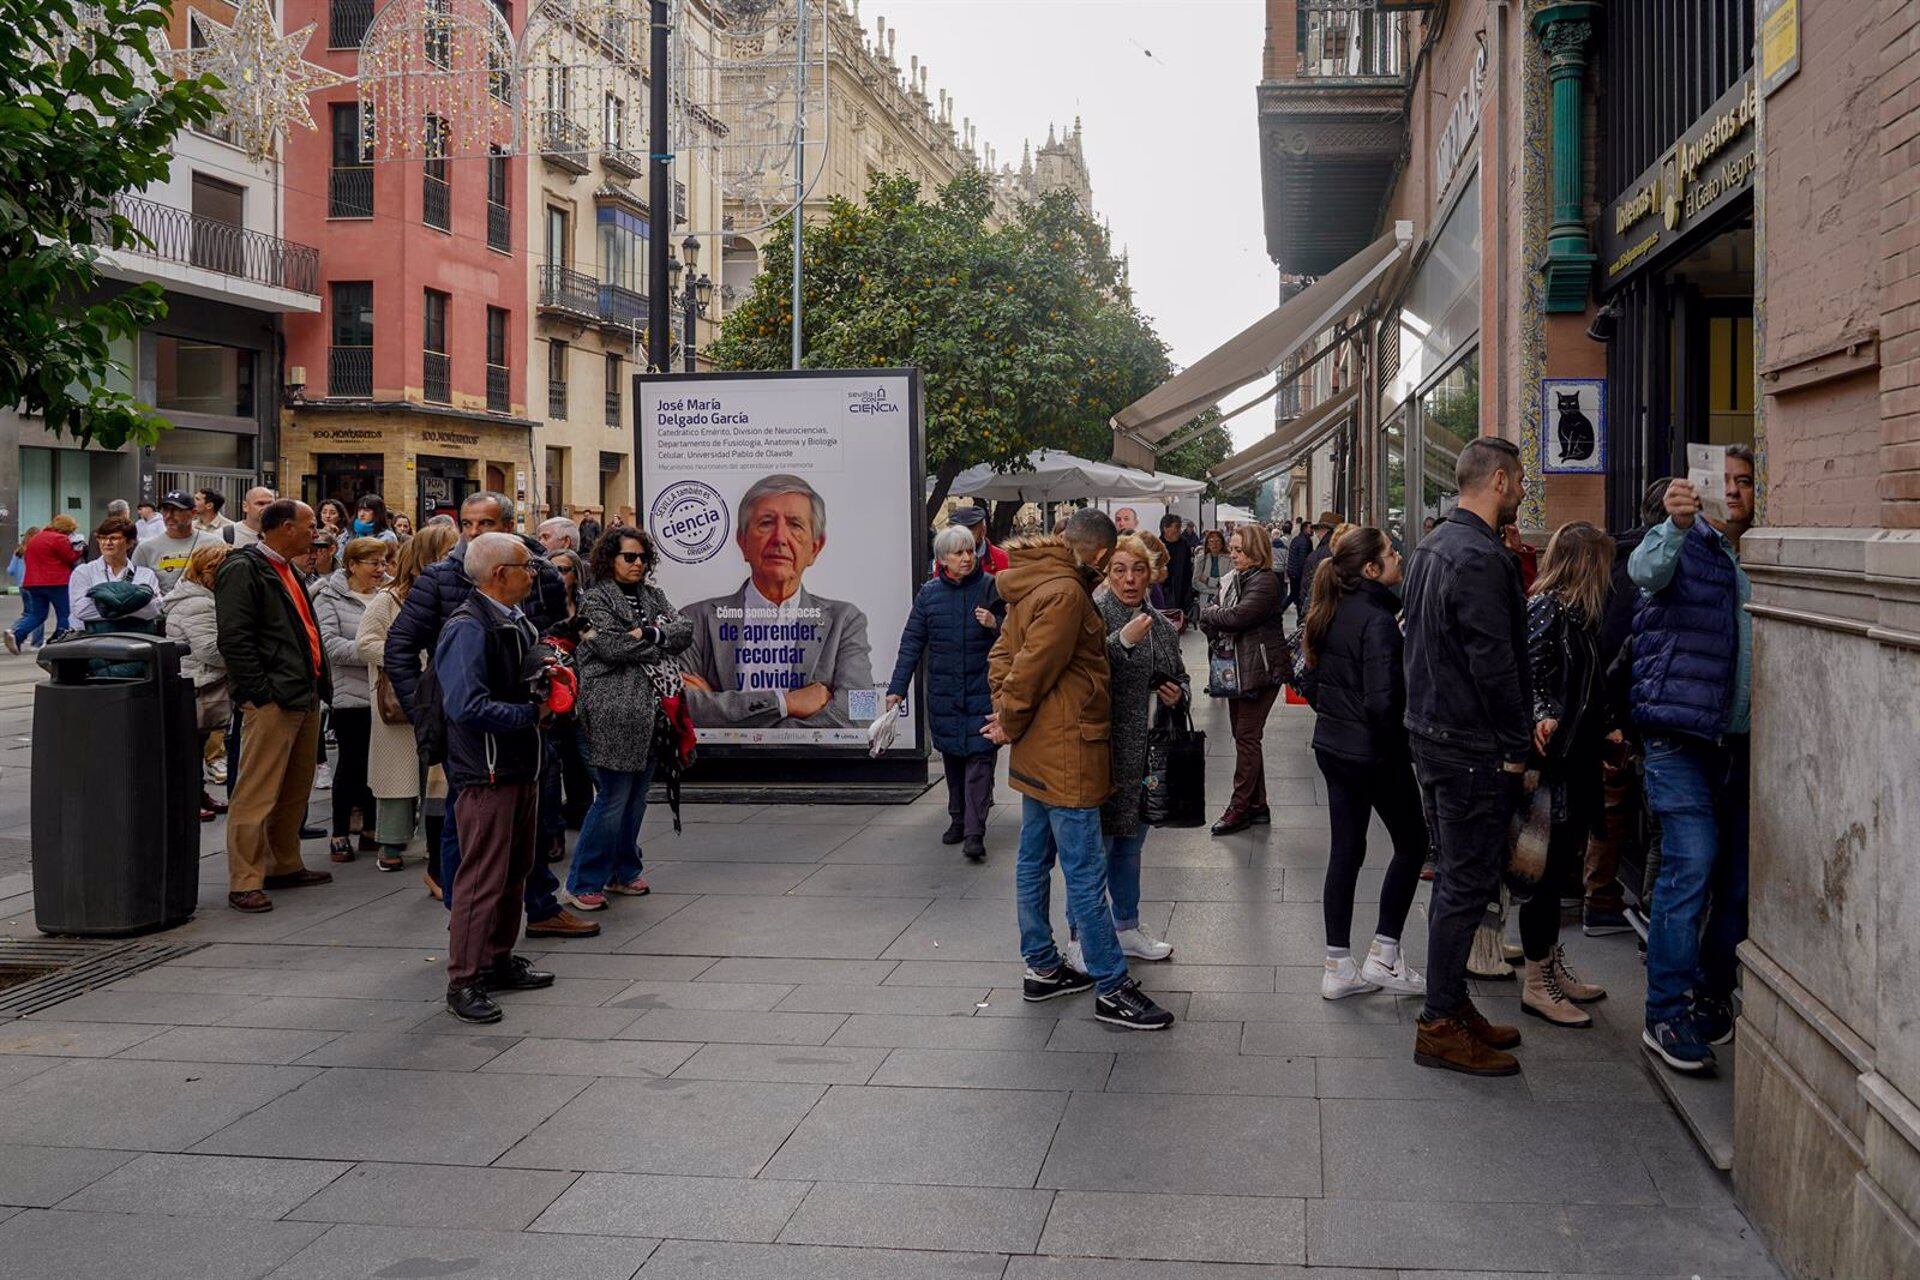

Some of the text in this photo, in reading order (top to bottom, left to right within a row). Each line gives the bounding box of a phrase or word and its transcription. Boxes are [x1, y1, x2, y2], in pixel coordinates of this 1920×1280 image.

[1681, 108, 1737, 183] Apuestas
[1685, 149, 1755, 219] El Gato Negro
[656, 397, 721, 411] José María
[658, 410, 749, 428] Delgado García
[764, 426, 774, 435] de
[657, 439, 711, 449] Departamento
[712, 439, 722, 447] de
[801, 438, 807, 447] y
[687, 449, 731, 459] Universidad
[755, 449, 765, 458] de
[662, 508, 720, 539] ciencia
[716, 605, 821, 620] Cómo somos capaces
[719, 621, 822, 643] de aprender,
[735, 645, 806, 664] recordar
[735, 669, 807, 691] y olvidar
